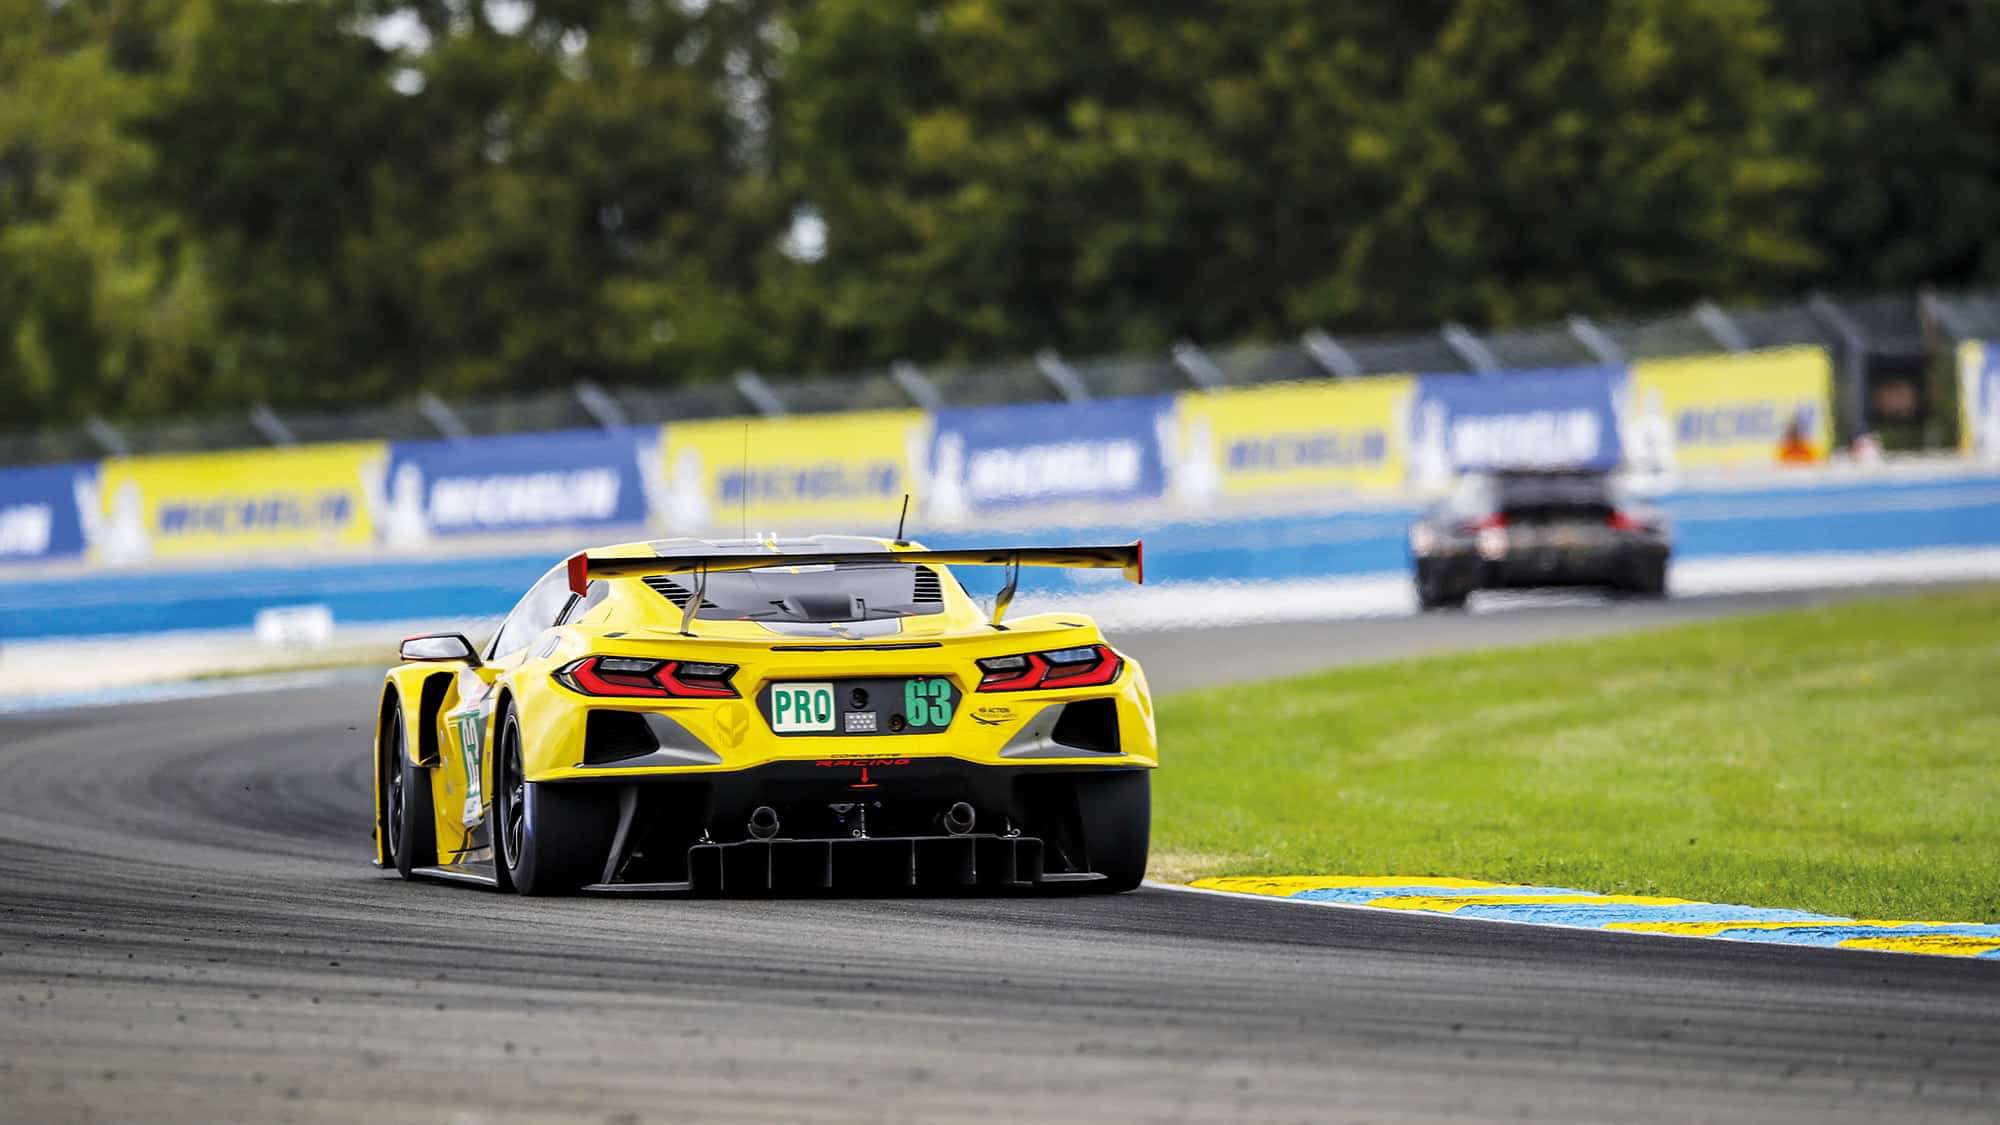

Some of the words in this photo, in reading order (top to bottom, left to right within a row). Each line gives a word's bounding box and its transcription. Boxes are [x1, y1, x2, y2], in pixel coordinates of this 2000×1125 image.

[719, 463, 897, 503] MICHELIN
[158, 493, 352, 534] MICHELIN
[775, 689, 832, 725] PRO
[905, 678, 953, 727] 63
[815, 758, 912, 768] RACING
